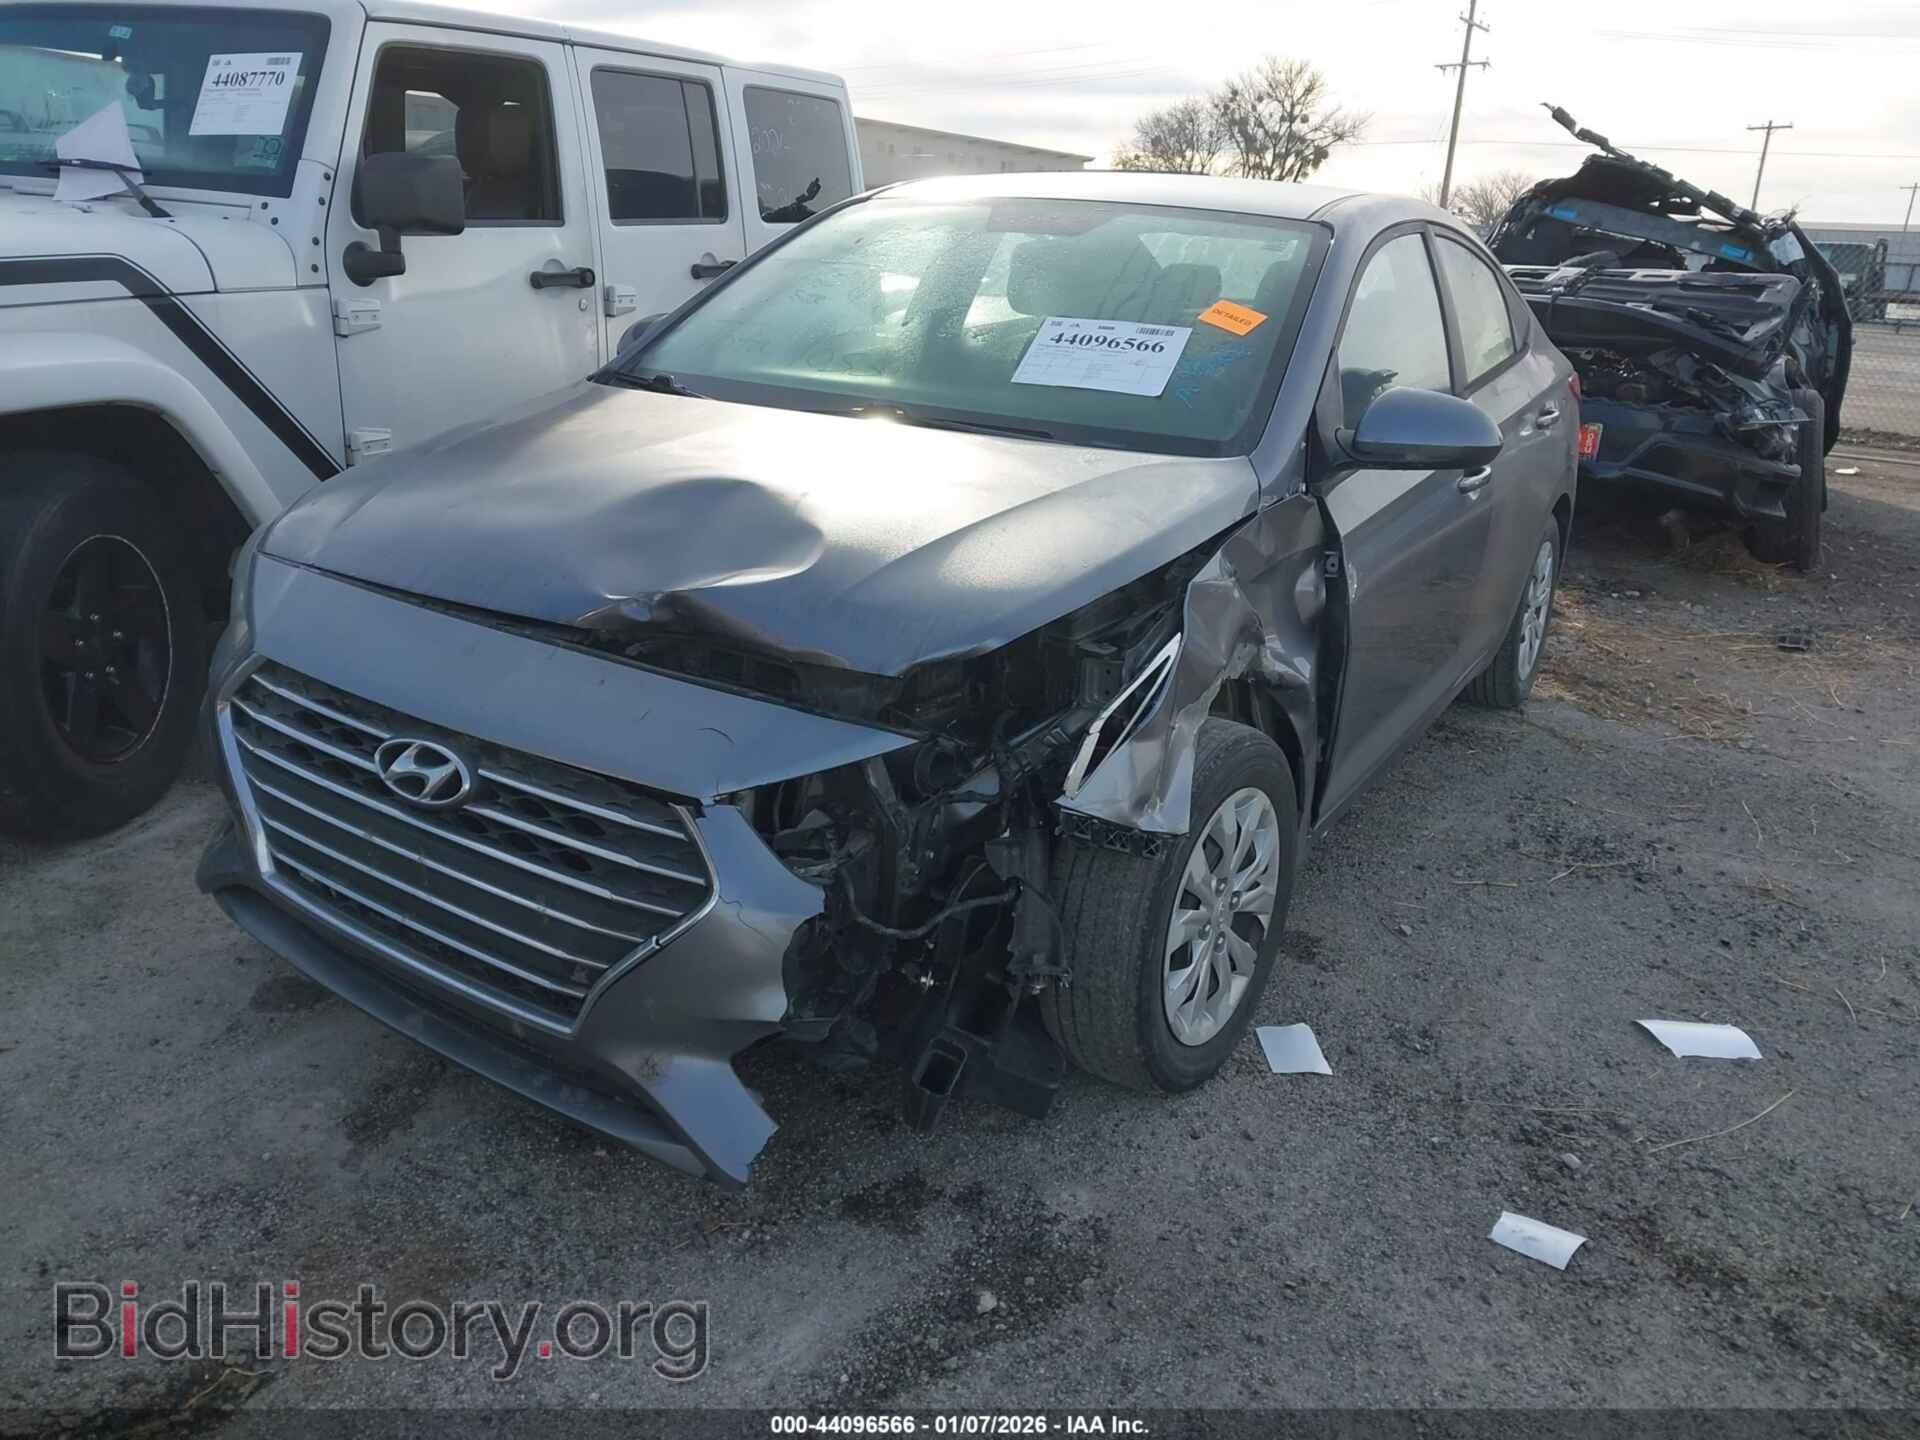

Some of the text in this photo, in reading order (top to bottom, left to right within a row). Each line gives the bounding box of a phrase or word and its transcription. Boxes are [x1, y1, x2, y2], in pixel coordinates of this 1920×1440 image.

[211, 71, 285, 87] 44087770
[1211, 307, 1253, 327] DETAILED
[1050, 331, 1166, 354] 44096566
